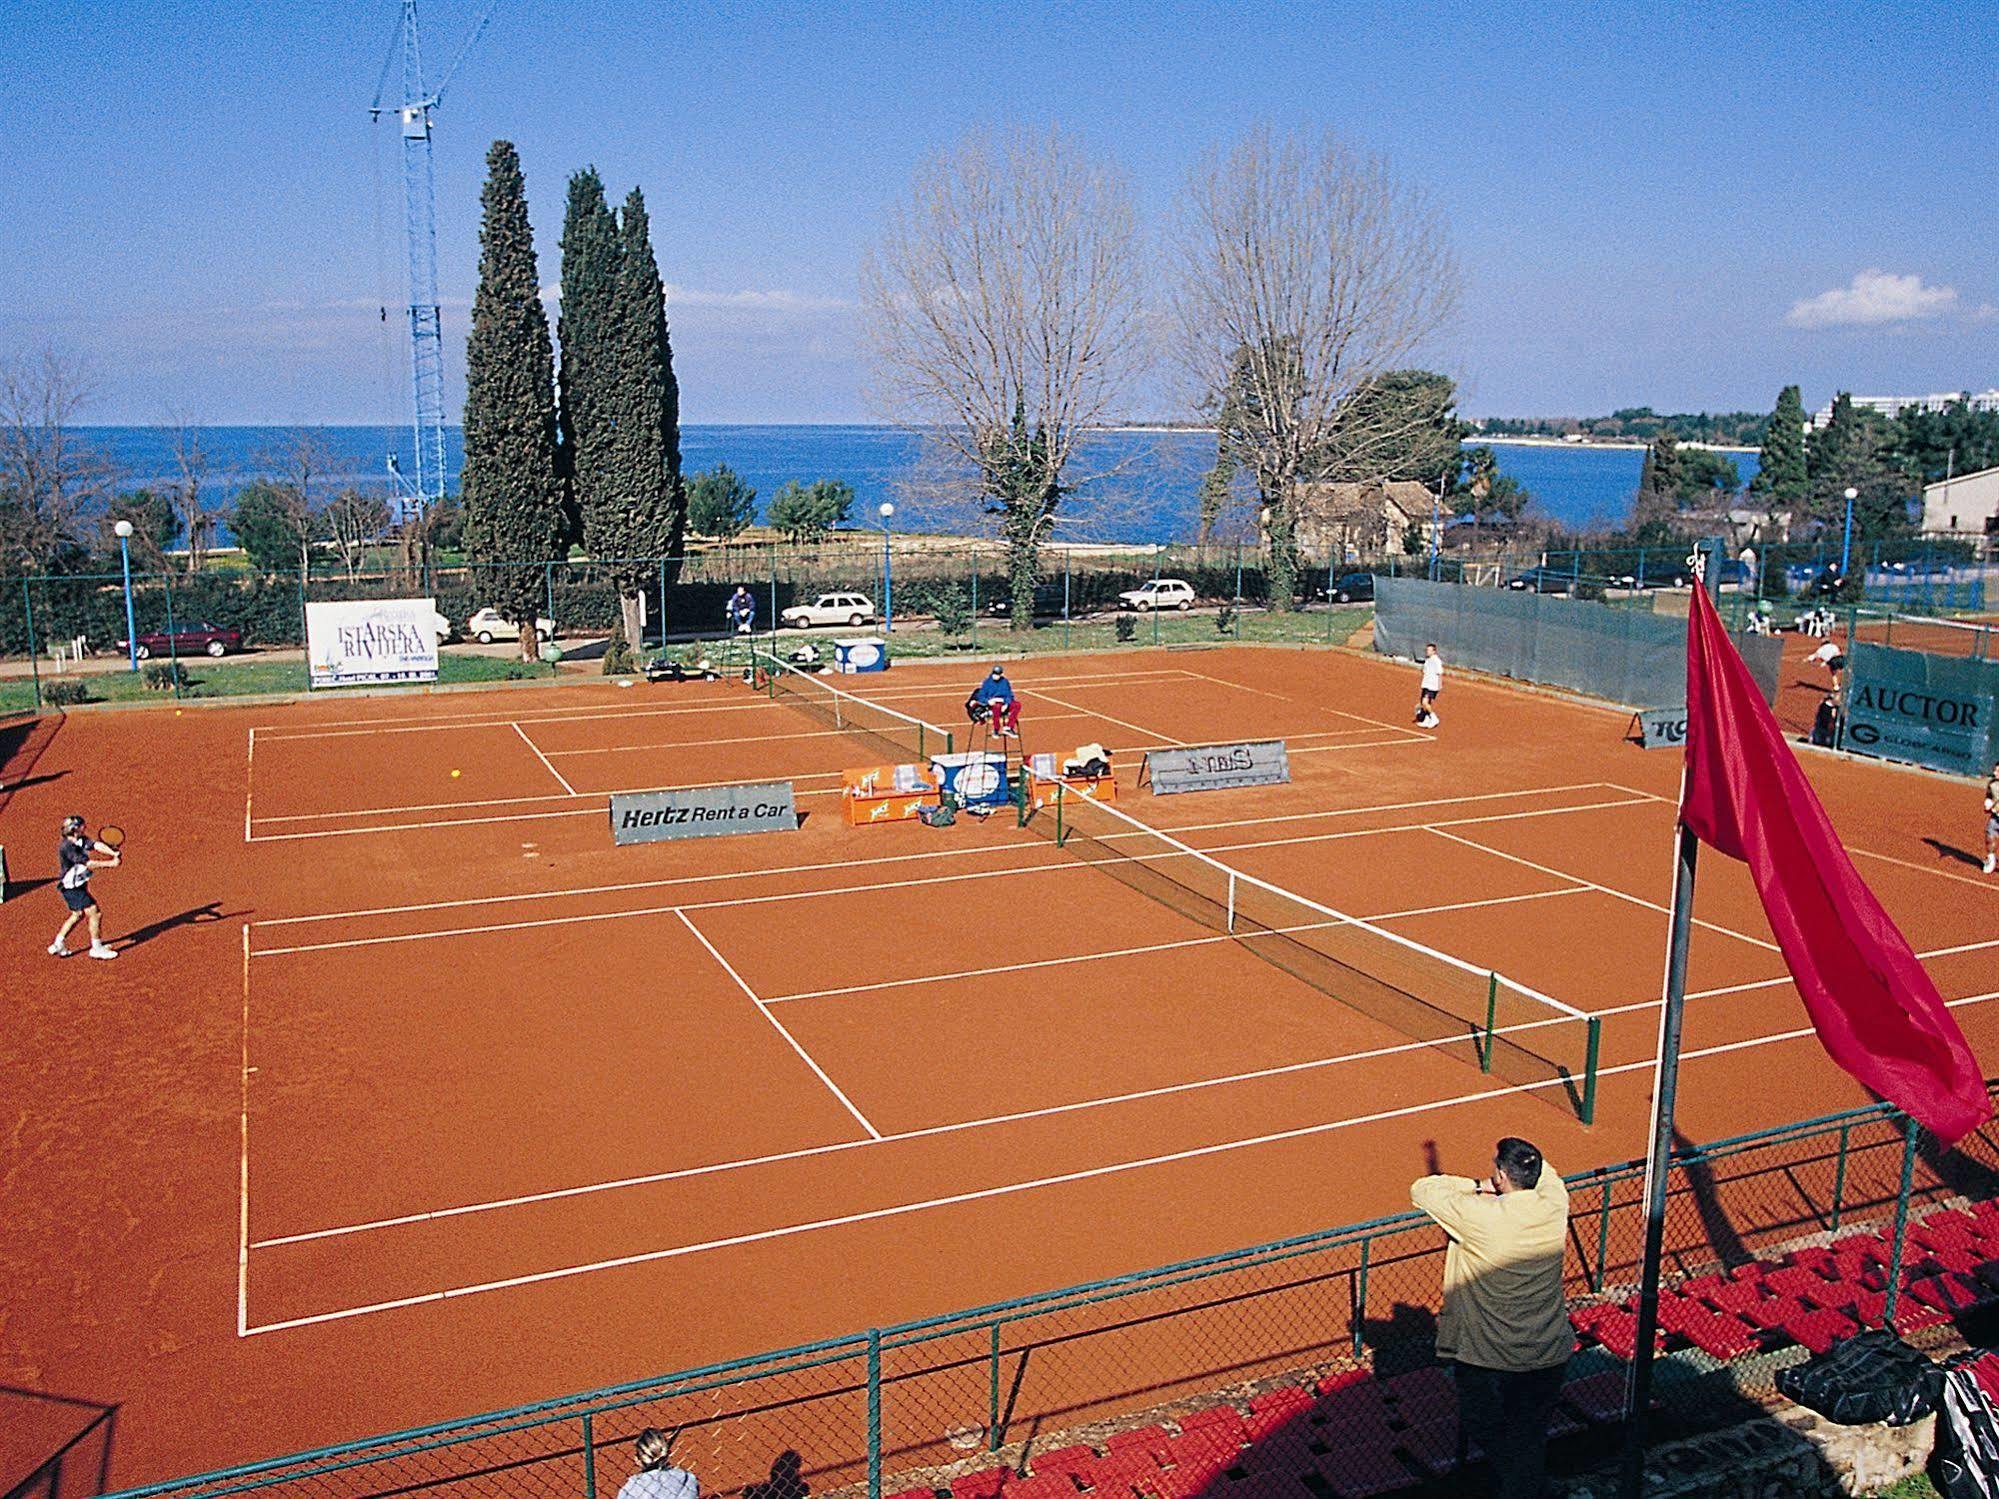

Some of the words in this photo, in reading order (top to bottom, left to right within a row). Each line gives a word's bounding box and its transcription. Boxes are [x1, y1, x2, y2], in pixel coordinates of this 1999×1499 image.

[338, 622, 420, 643] ISTARSKA
[1855, 685, 1979, 727] AUCTOR
[622, 806, 690, 829] Hertz
[691, 806, 736, 822] Rent
[740, 809, 749, 819] a
[754, 803, 788, 817] Car
